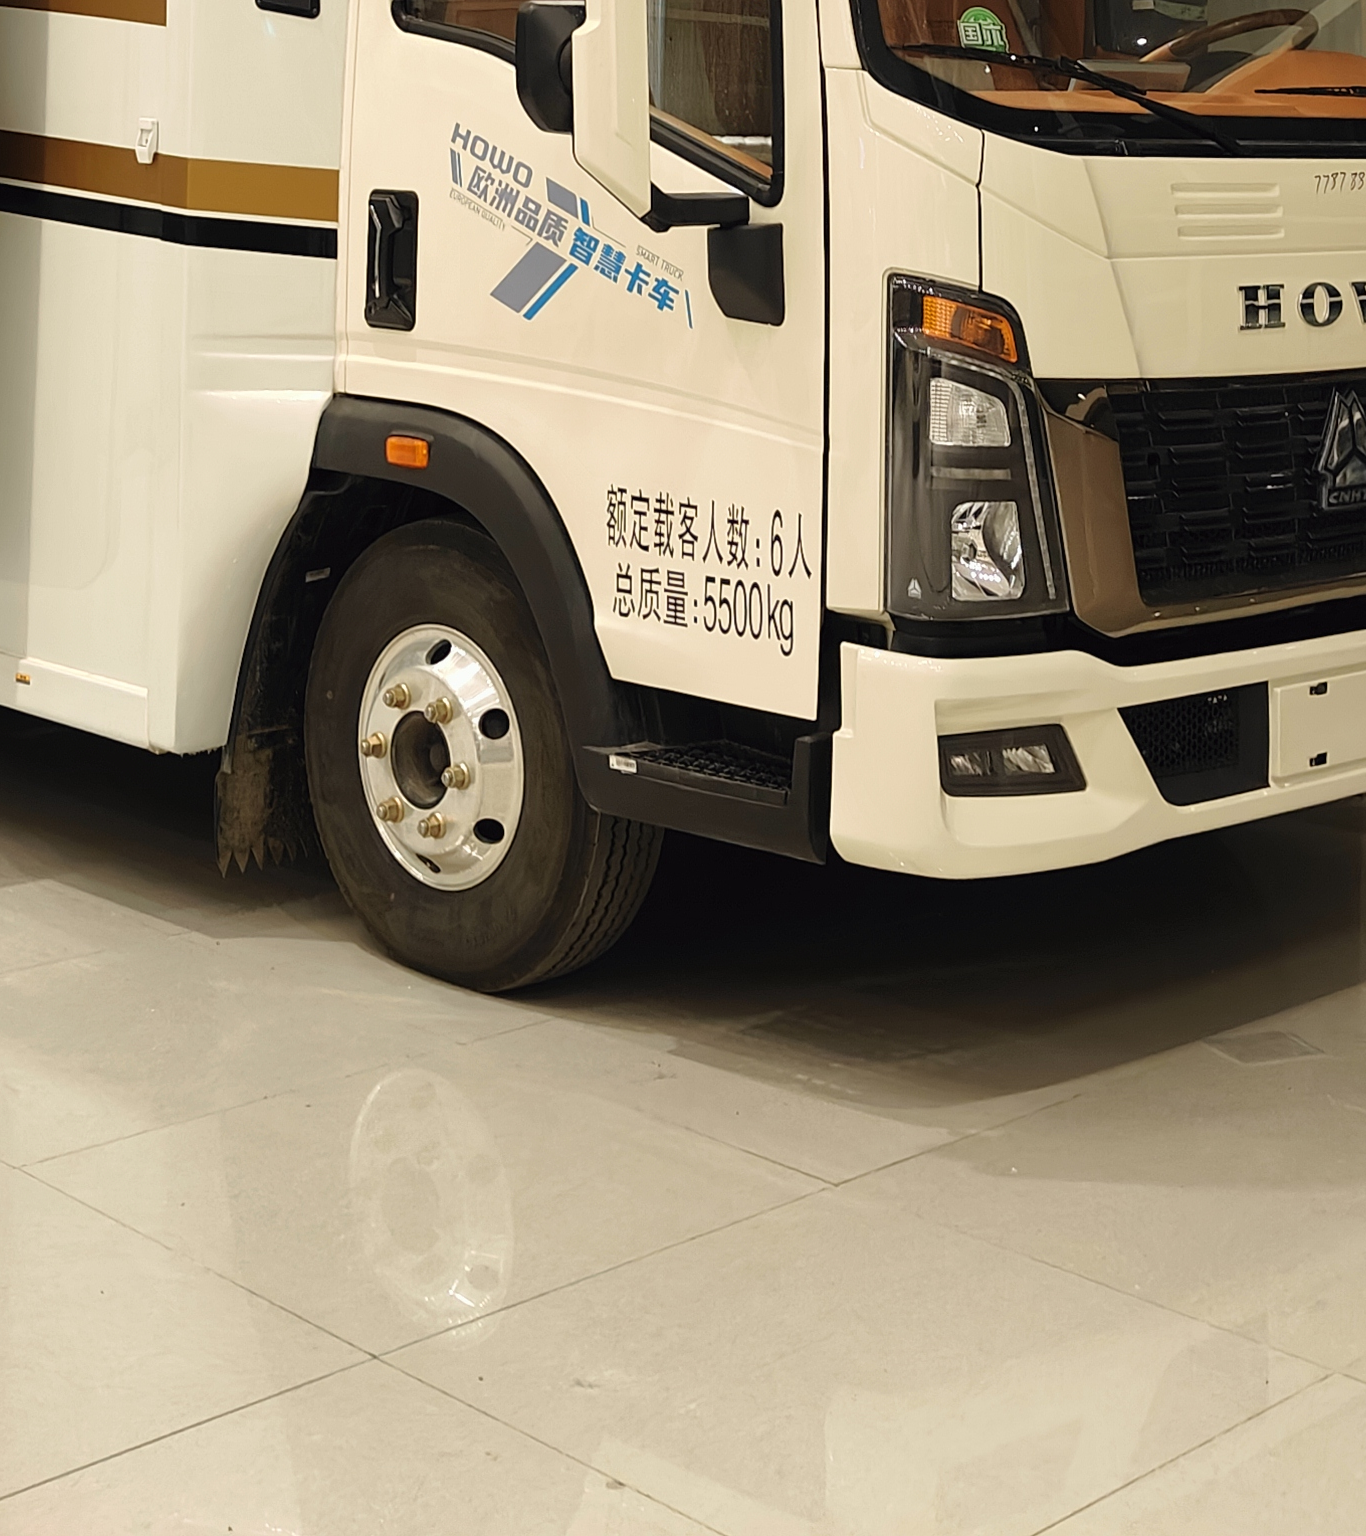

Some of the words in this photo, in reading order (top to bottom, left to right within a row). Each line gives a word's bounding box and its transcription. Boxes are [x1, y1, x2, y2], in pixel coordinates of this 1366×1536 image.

[450, 122, 533, 189] HOWO
[466, 165, 569, 248] 欧洲品质
[569, 227, 680, 312] 智慧卡车
[636, 245, 660, 270] SMART
[661, 260, 685, 282] TRUCK
